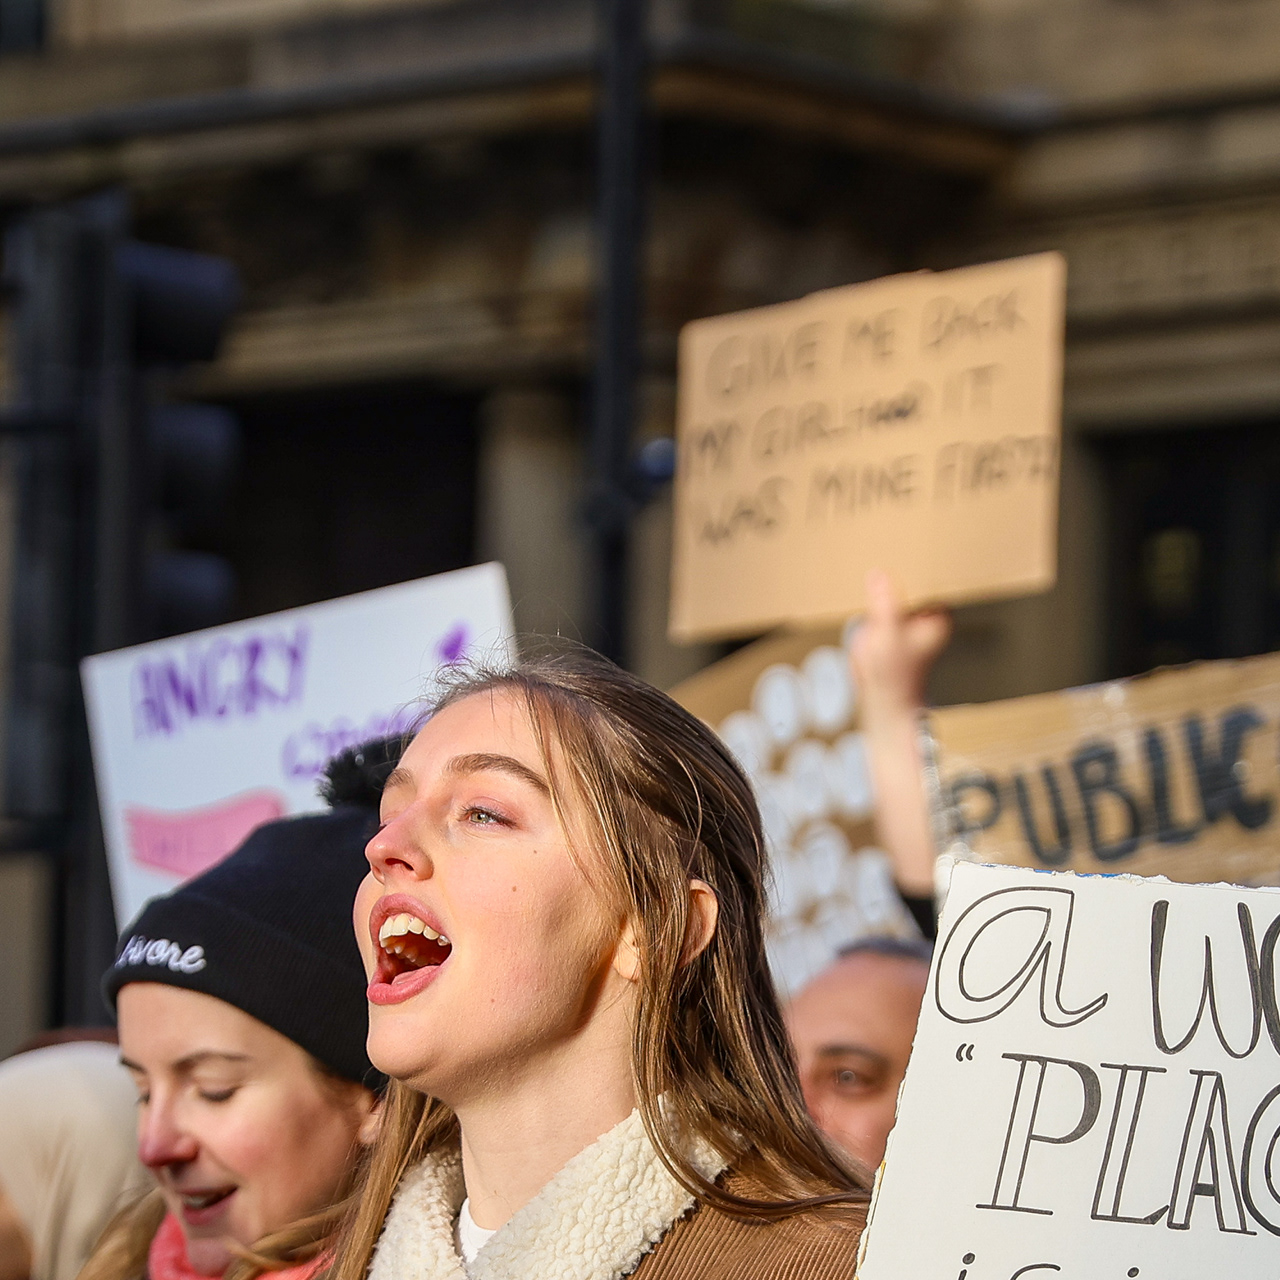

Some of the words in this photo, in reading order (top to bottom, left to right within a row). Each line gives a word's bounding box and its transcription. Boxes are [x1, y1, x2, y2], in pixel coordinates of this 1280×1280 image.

[706, 320, 828, 398] GIVE
[841, 307, 902, 371] ME
[807, 453, 922, 526] MINE
[131, 618, 311, 740] ANGRY
[945, 704, 1276, 865] PUBLIC
[934, 886, 1108, 1028] a
